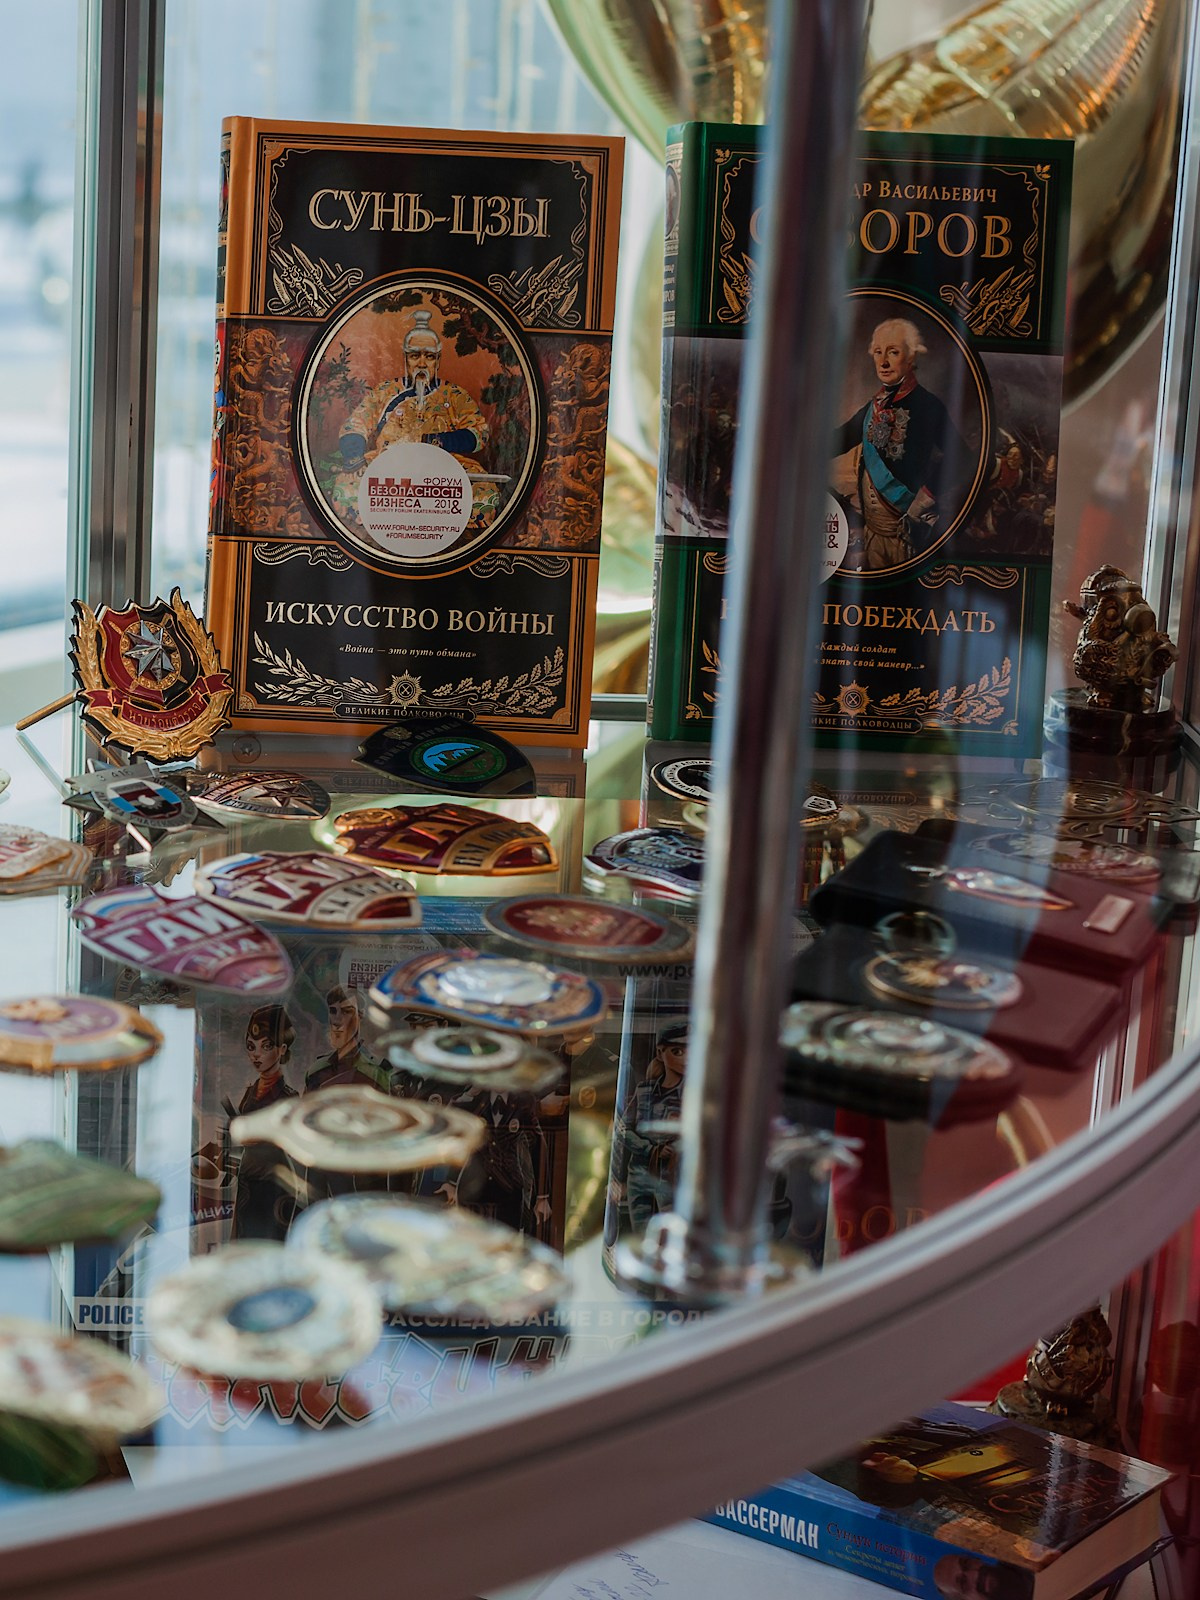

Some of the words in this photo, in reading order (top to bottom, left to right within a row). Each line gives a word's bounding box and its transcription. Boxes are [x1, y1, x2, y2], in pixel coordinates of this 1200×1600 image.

[308, 189, 551, 245] СУНЬ-ЦЗЫ
[750, 206, 1012, 258] ОРОВ
[423, 477, 462, 487] ФОРУМ
[370, 486, 462, 498] БЕЗОПАСНОСТЬ
[370, 498, 421, 508] БИЗНЕСА
[369, 524, 460, 532] WWW.FORUM-SECURITY.RU
[264, 601, 439, 630] ИСКУССТВО
[447, 606, 554, 636] ВОЙНЫ
[822, 603, 996, 636] ПОБЕЖДАТЬ
[388, 648, 407, 656] это
[409, 648, 434, 658] путь
[861, 645, 897, 654] солдат
[820, 658, 851, 666] знать
[853, 658, 875, 668] свой
[345, 707, 391, 717] ВЕЛИКИЕ
[393, 708, 465, 720] ПОЛКОВОЦЫ
[841, 718, 912, 729] ПОЛКОВОДЦЫ
[230, 858, 372, 910] ГАИ
[103, 902, 243, 961] ГАИ
[79, 1304, 144, 1325] POLICE
[601, 1310, 614, 1326] В
